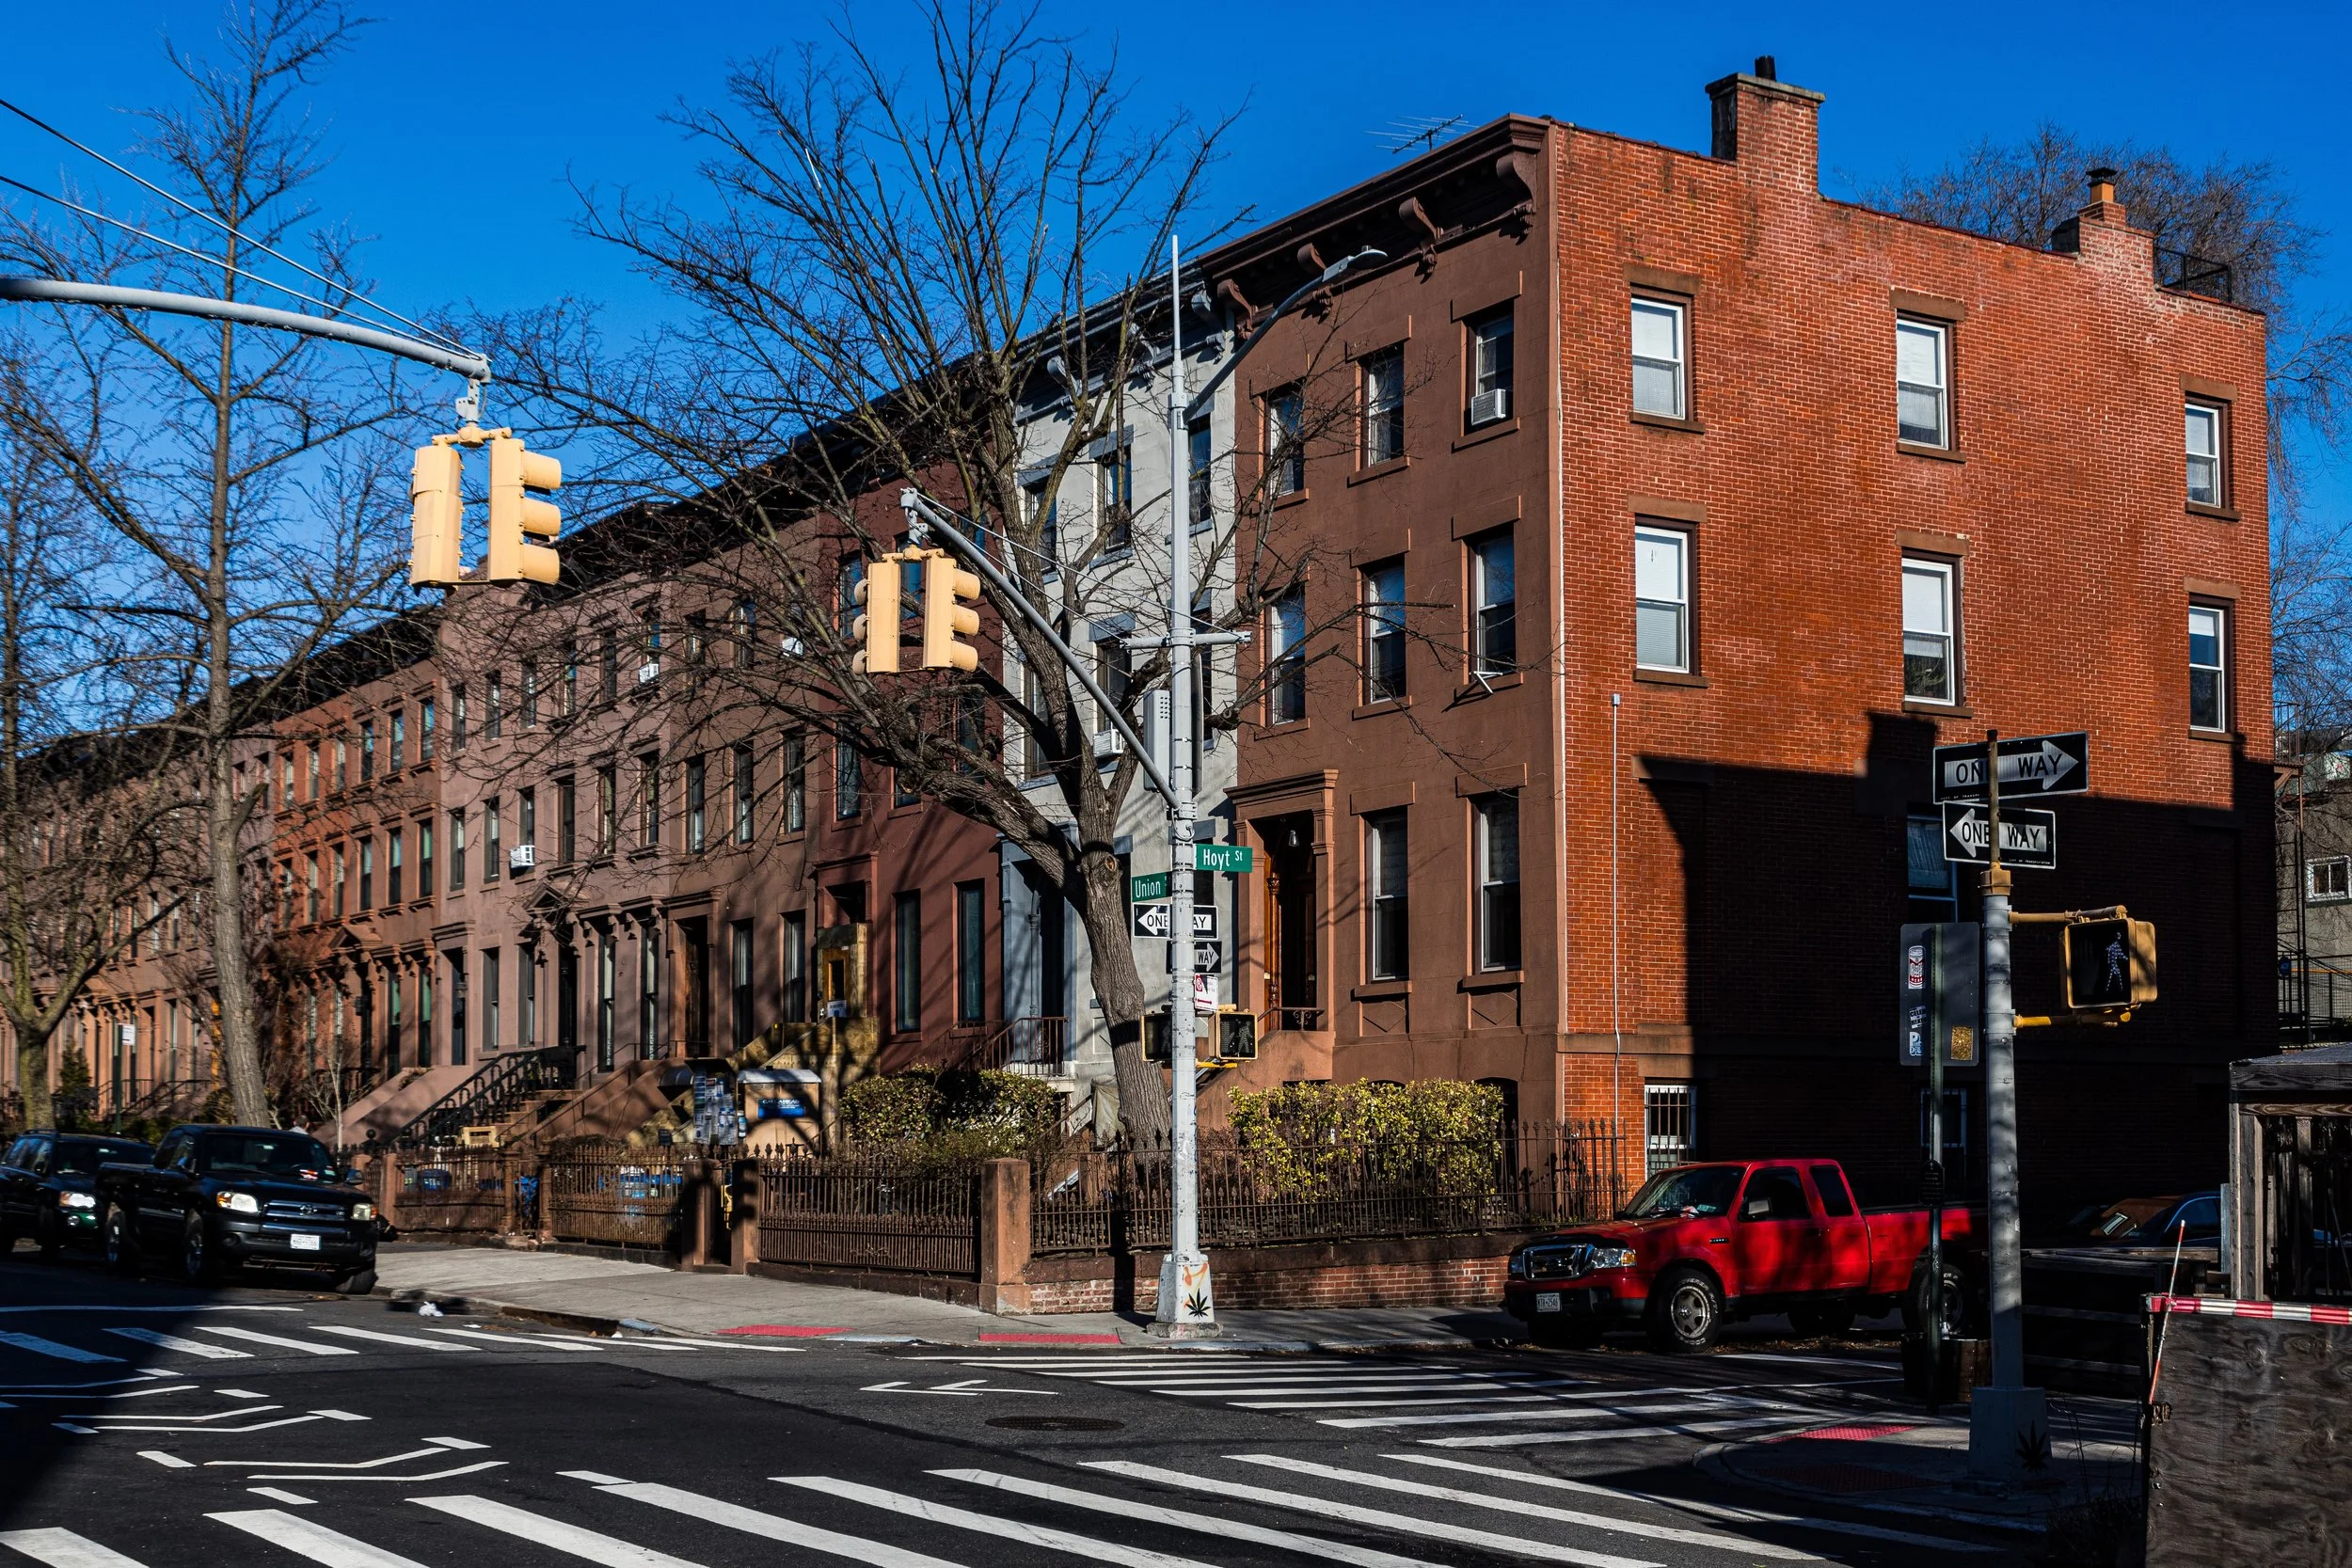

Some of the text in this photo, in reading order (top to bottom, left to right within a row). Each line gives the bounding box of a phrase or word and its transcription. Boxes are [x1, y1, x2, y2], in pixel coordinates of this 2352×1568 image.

[1956, 753, 2063, 784] ON WAY
[1962, 821, 2041, 848] ONE WAY
[1202, 848, 1243, 870] Hoyt St
[1135, 879, 1162, 898] Union
[1147, 914, 1207, 929] ONE AY
[1198, 950, 1215, 964] WAY
